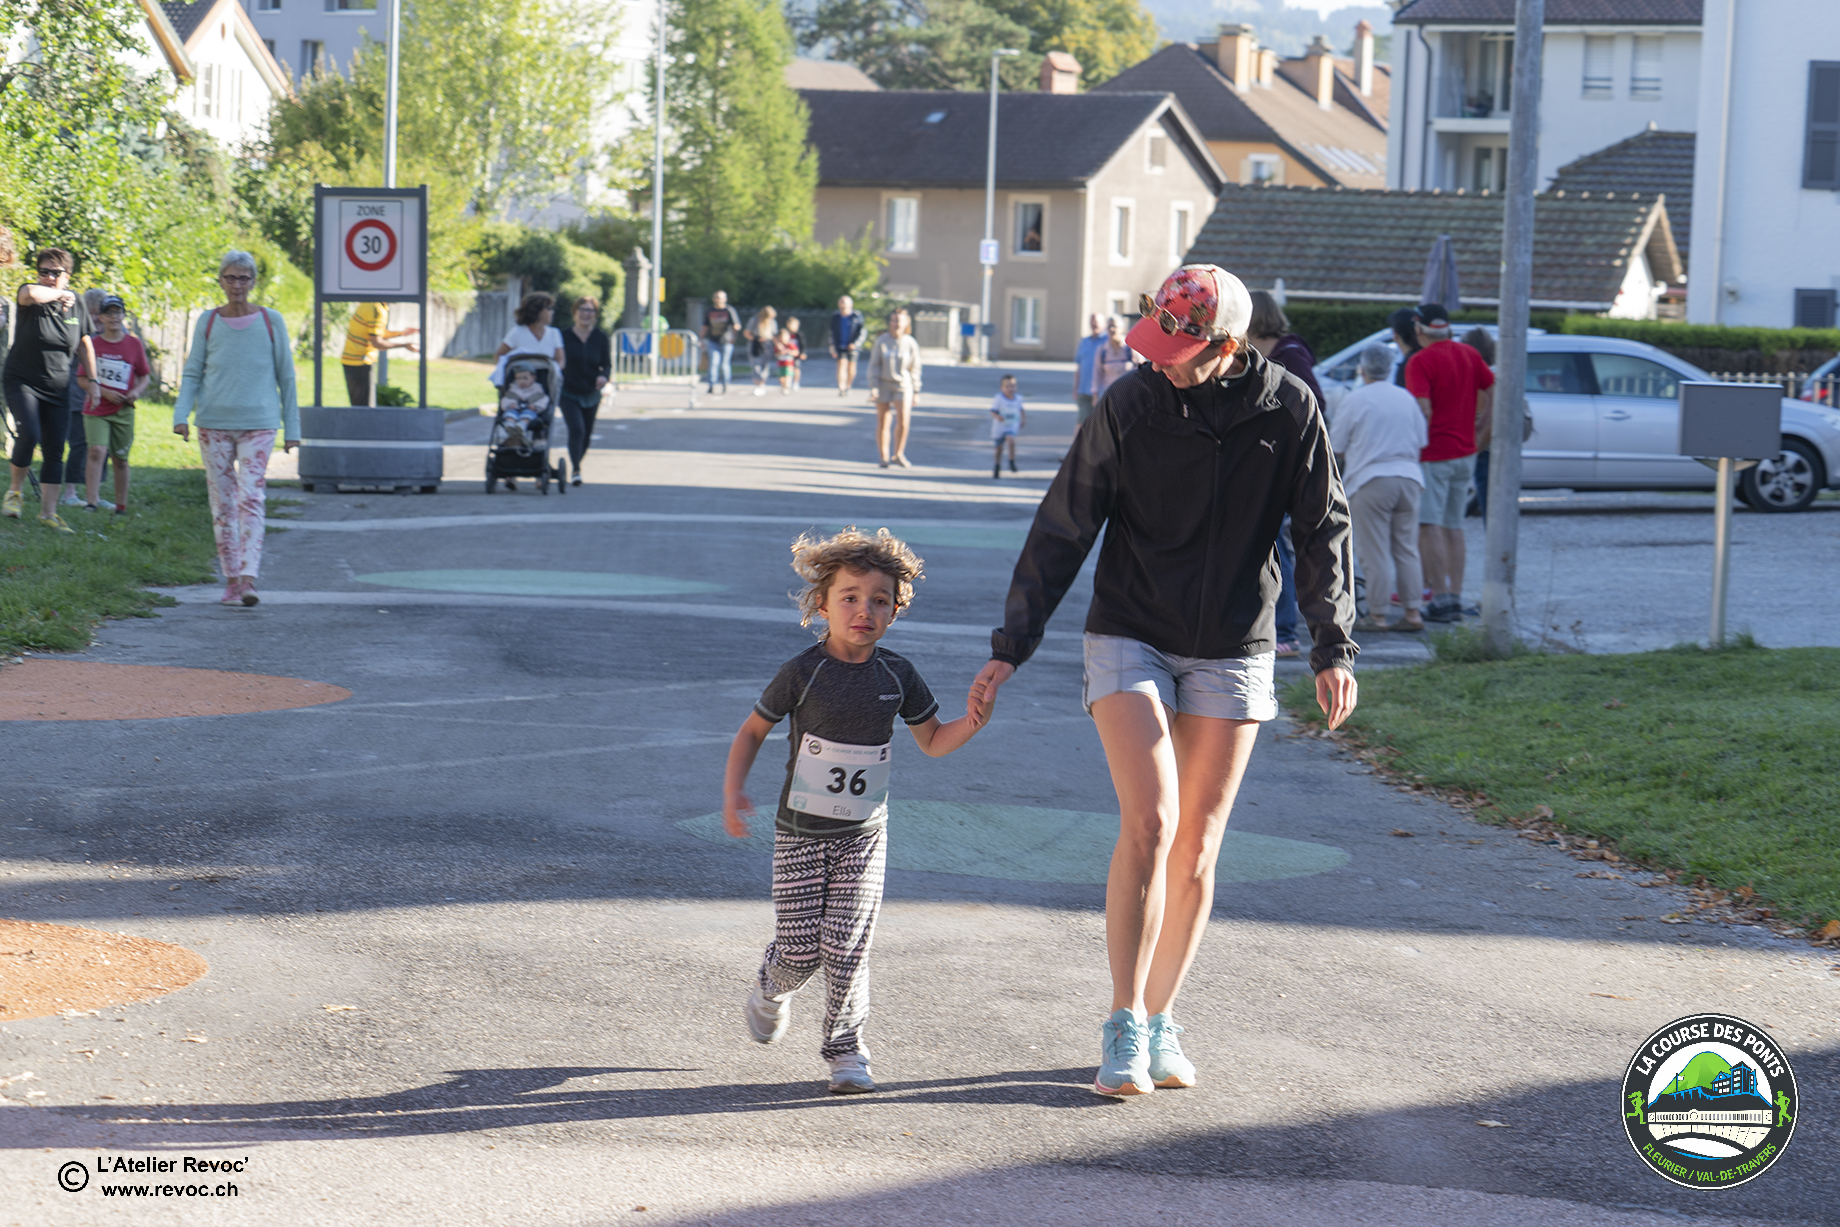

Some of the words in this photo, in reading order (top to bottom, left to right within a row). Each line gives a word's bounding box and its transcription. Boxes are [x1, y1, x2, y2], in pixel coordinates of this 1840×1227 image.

[356, 205, 386, 217] ZONE
[361, 235, 382, 254] 30
[826, 767, 867, 796] 36
[832, 805, 852, 817] Ella
